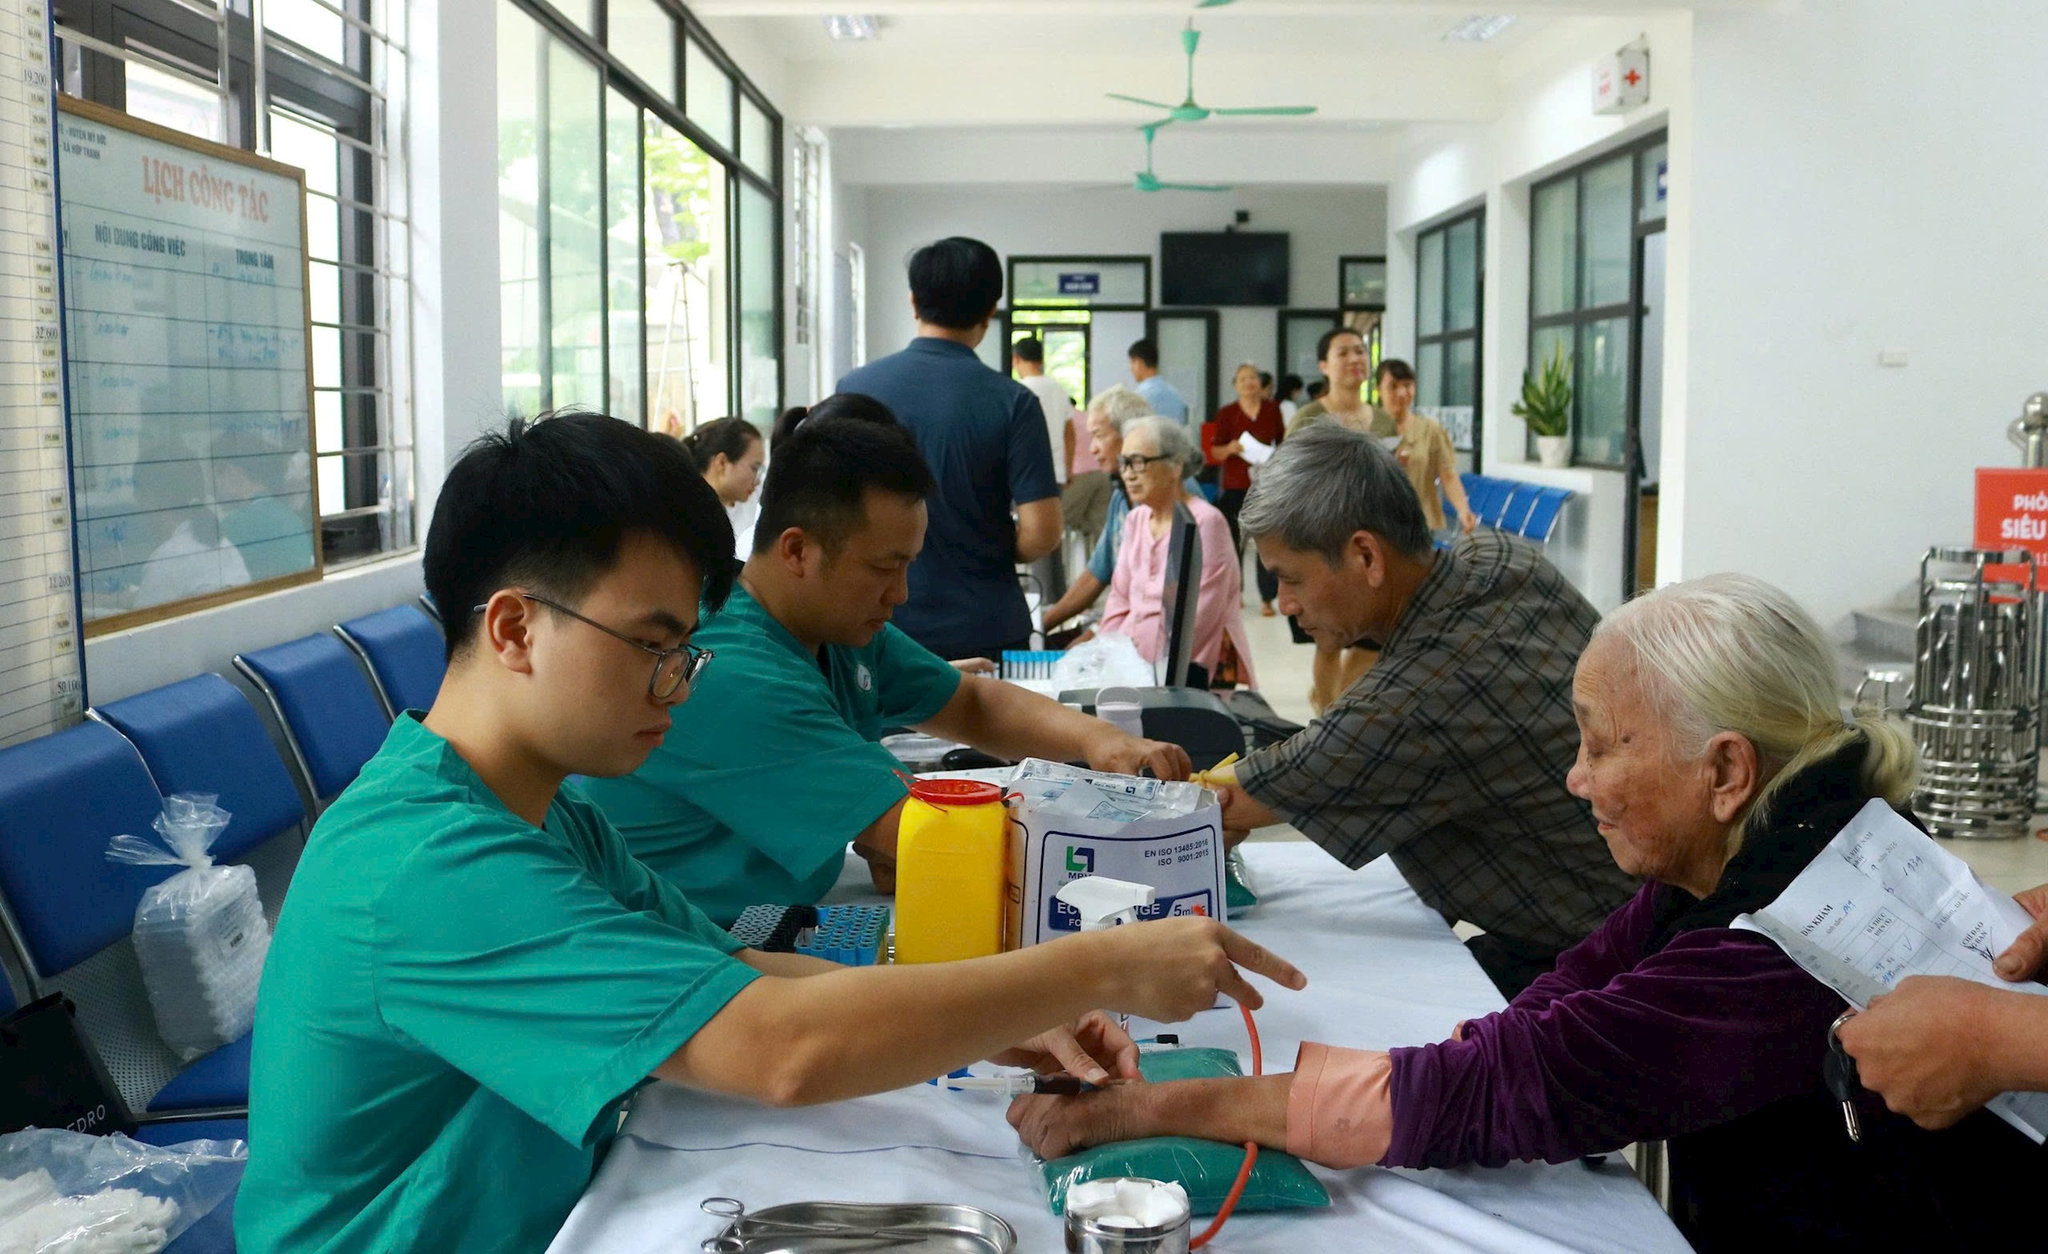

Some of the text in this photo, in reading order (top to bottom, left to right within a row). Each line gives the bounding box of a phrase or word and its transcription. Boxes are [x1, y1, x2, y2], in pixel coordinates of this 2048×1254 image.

[142, 155, 269, 223] LỊCH CÔNG TÁC
[95, 221, 112, 248] NỘI
[113, 227, 138, 250] DUNG
[141, 229, 166, 254] CÔNG
[167, 235, 186, 260] VIỆC
[2001, 512, 2046, 541] SIÊU
[1144, 838, 1209, 858] EN ISO 13485:2016
[1158, 849, 1209, 866] ISO 9001:2015
[1057, 902, 1078, 915] EC
[1136, 903, 1160, 915] GE
